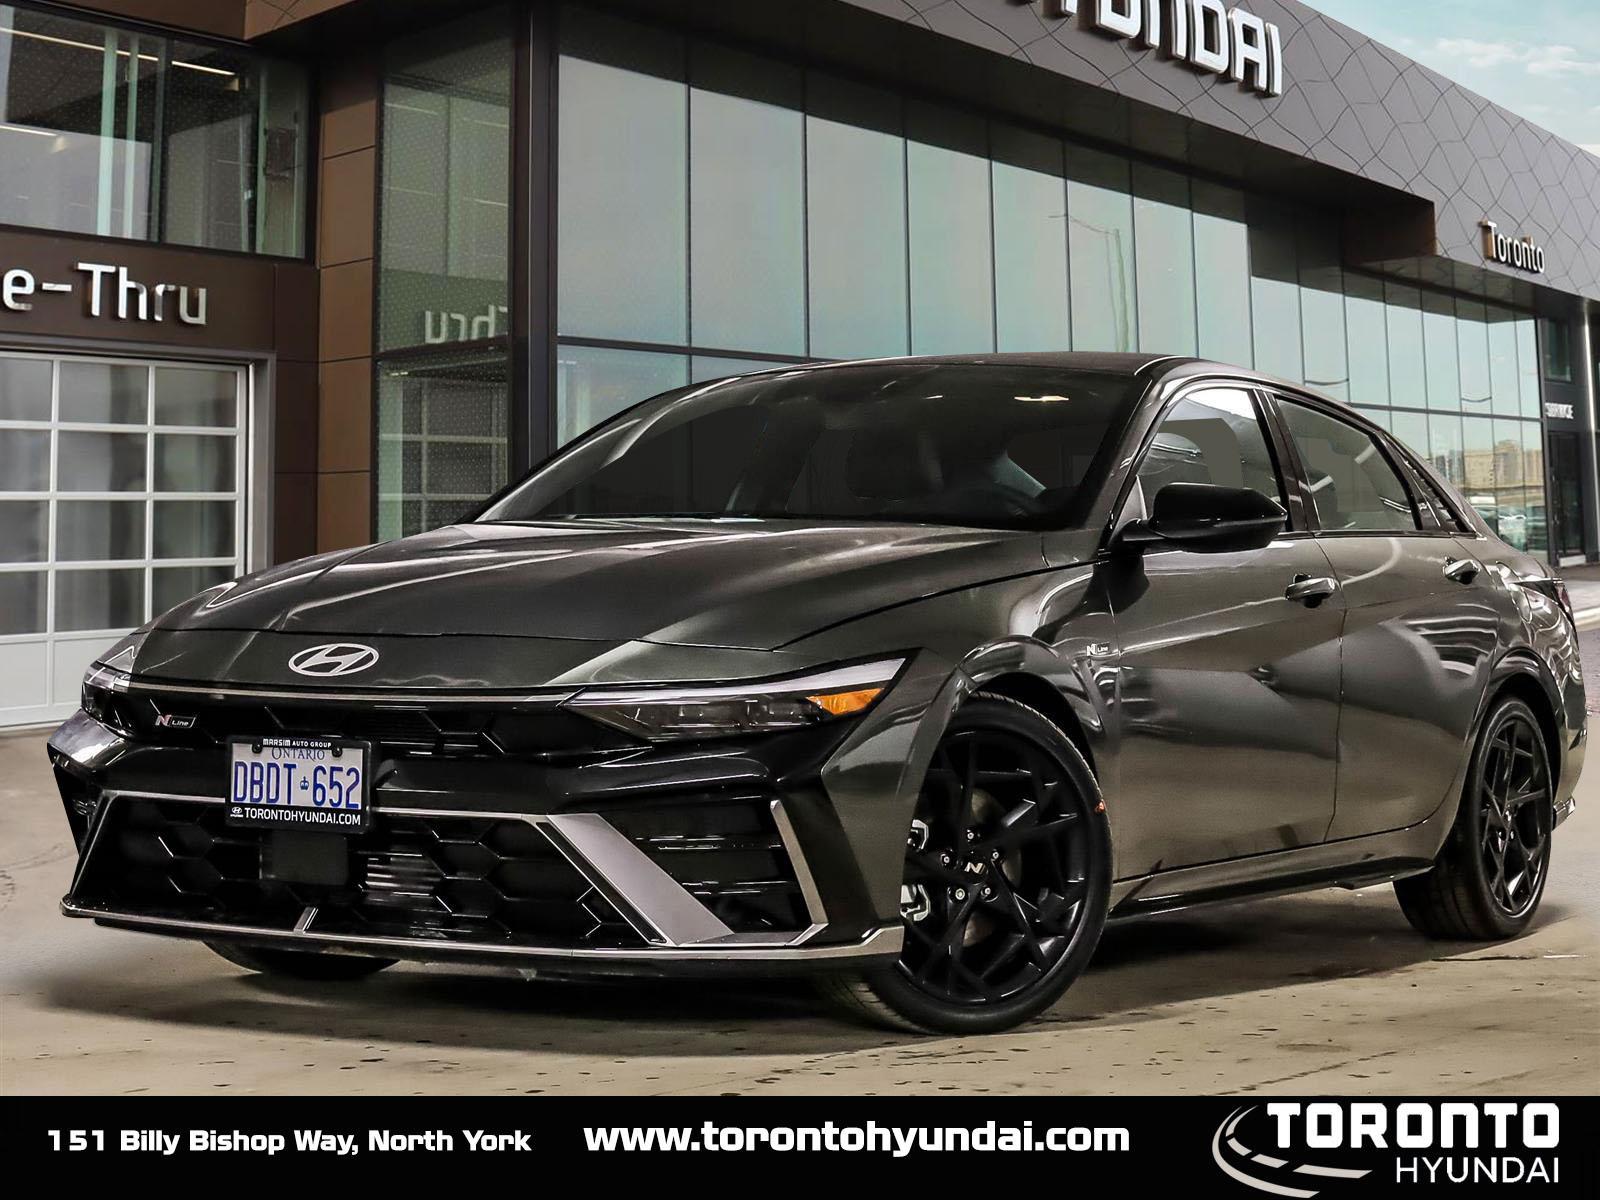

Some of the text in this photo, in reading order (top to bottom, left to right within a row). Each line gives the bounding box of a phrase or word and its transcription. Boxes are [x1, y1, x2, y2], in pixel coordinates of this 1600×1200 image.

[1486, 220, 1545, 273] Toronto
[233, 761, 360, 809] DBDT 652
[244, 807, 361, 825] TORONTOHYUNDAI.COM
